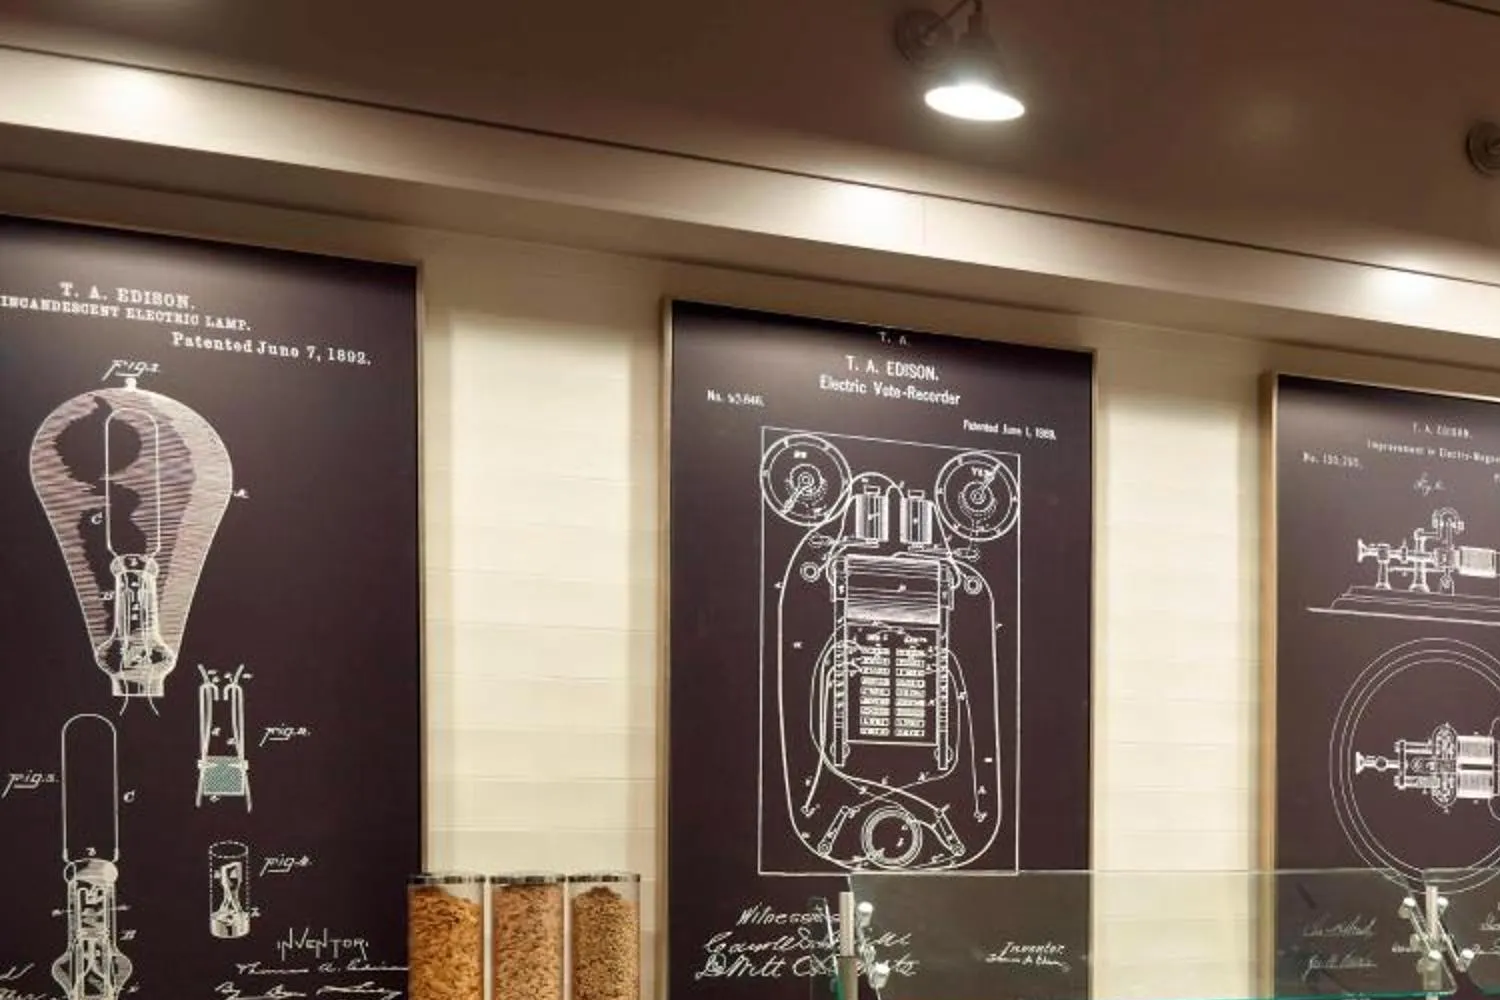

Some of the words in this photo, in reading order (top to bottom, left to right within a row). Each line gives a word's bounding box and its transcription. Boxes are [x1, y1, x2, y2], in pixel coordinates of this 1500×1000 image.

[60, 281, 79, 298] T.
[90, 285, 108, 301] A.
[116, 287, 196, 310] EDISON.
[0, 295, 120, 317] INCANDESCENT
[126, 307, 200, 326] ELECTRIC
[205, 315, 251, 331] LAMP.
[171, 331, 252, 353] Patented
[257, 340, 299, 358] June
[306, 345, 321, 361] 7,
[846, 354, 859, 372] T.
[865, 358, 879, 374] A.
[887, 361, 939, 381] EDISON.
[820, 374, 867, 395] Electric
[874, 380, 961, 406] Vote-Recorder
